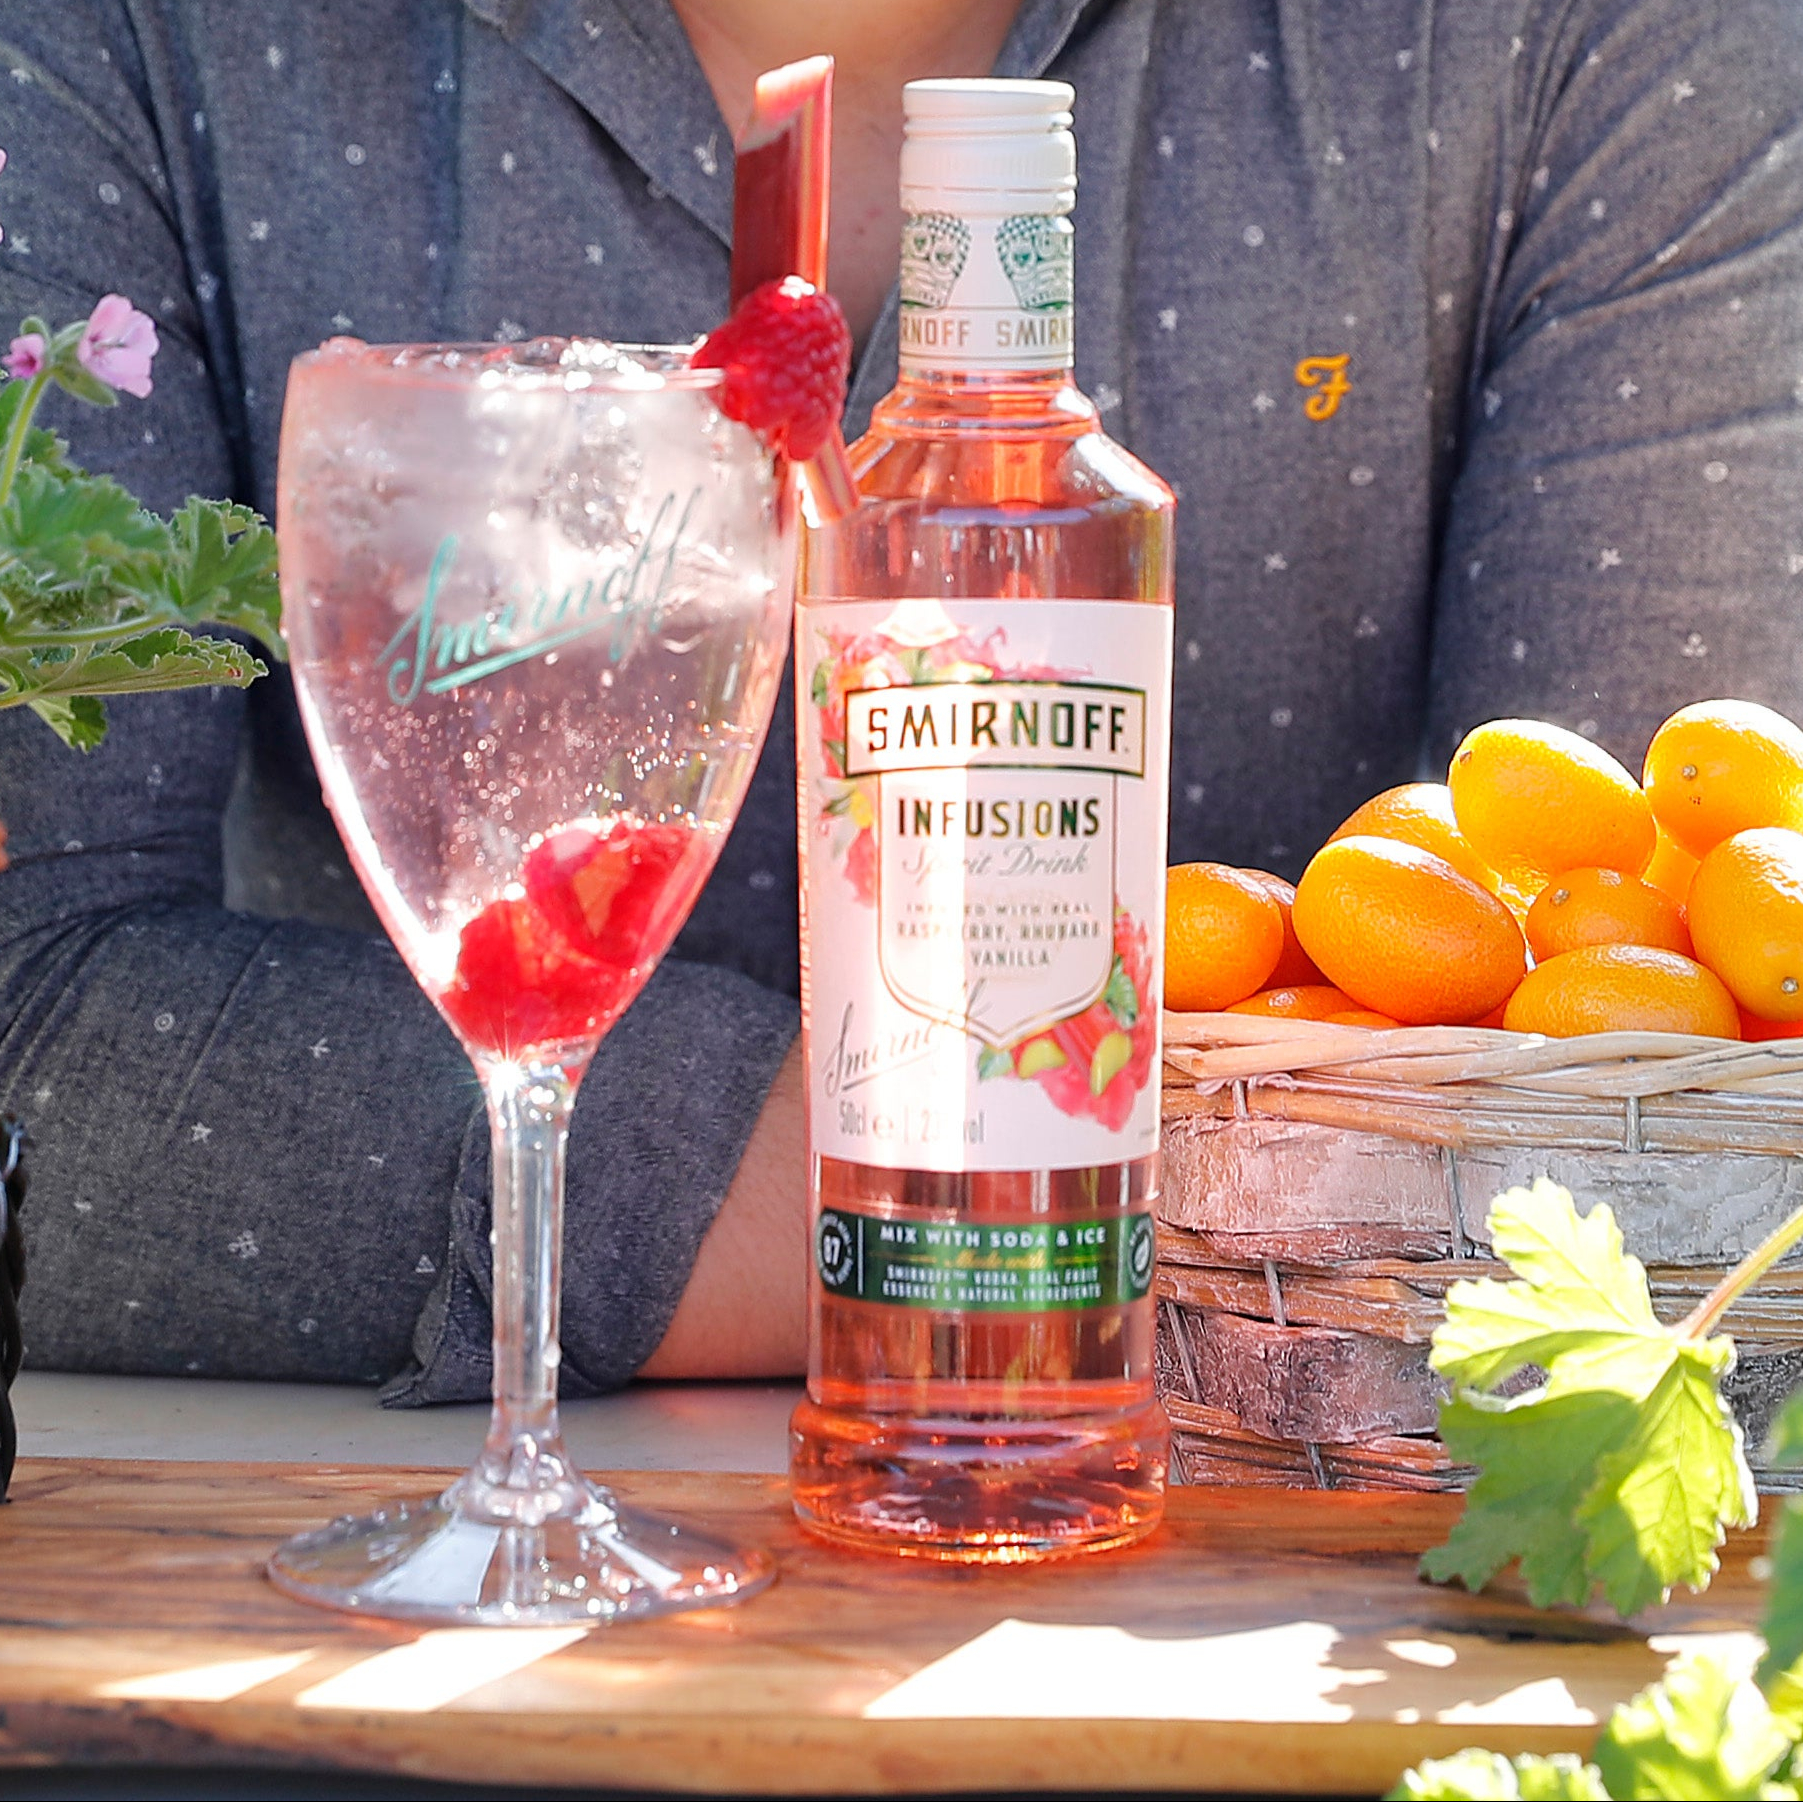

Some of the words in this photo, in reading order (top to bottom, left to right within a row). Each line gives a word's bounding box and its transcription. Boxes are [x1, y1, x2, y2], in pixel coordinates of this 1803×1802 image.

[373, 485, 703, 705] Smirnoff
[867, 700, 1126, 753] SMIRNOFF
[897, 797, 1100, 839] INFUSIONS
[998, 841, 1090, 877] Drink
[971, 950, 1050, 967] VANILLA
[880, 1225, 917, 1244] MIX
[926, 1228, 980, 1248] WITH
[989, 1231, 1047, 1248] SODA
[1056, 1229, 1069, 1246] &
[1076, 1226, 1106, 1245] ICE
